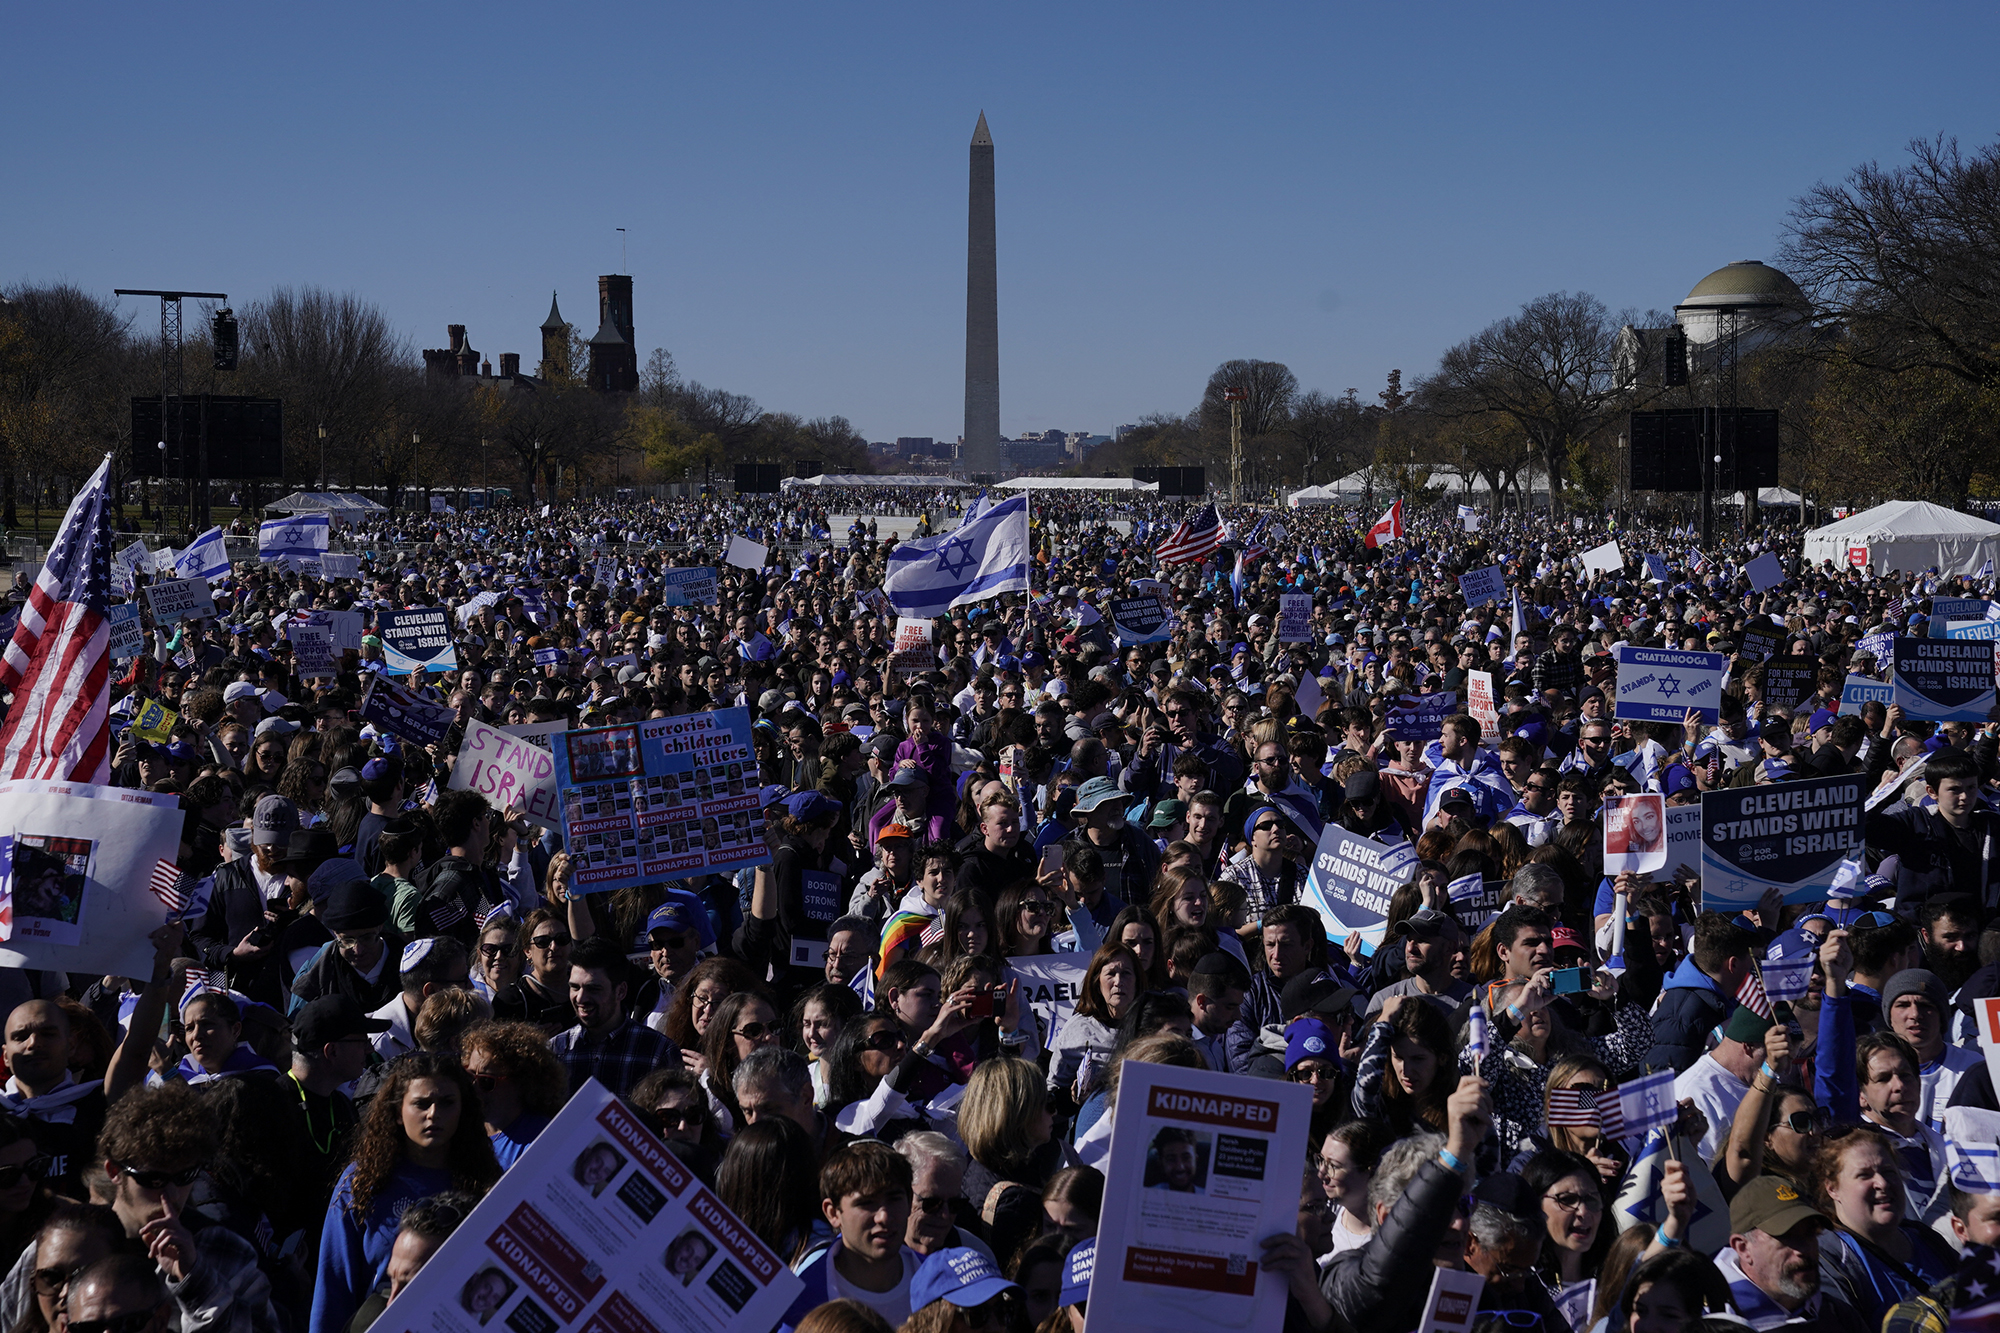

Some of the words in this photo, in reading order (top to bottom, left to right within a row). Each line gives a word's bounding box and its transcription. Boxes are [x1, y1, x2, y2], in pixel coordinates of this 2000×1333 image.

[599, 564, 615, 572] אחד
[670, 568, 708, 584] CLEVELAND
[1463, 569, 1489, 584] PHILLY
[152, 583, 190, 597] PHILLY
[682, 579, 712, 591] STRONGER
[1465, 581, 1482, 590] STANDS
[1467, 585, 1496, 599] ISRAEL
[154, 595, 179, 605] STANDS
[179, 592, 194, 600] WITH
[683, 590, 699, 599] THAN
[700, 587, 714, 597] HATE
[157, 600, 198, 615] ISRAEL
[1121, 598, 1158, 610] CLEVELAND
[1937, 601, 1981, 614] CLEVELAND
[394, 612, 444, 626] CLEVELAND
[1116, 609, 1142, 620] STANDS
[1142, 606, 1161, 616] WITH
[1140, 615, 1164, 626] ISRAEL
[123, 631, 141, 644] HATE
[300, 632, 320, 640] FREE
[384, 626, 422, 639] STANDS
[422, 624, 447, 635] WITH
[904, 626, 923, 635] FREE
[418, 636, 450, 648] ISRAEL
[895, 641, 931, 651] SUPPORT
[1745, 633, 1764, 644] BRING
[1765, 637, 1777, 647] THE
[1858, 632, 1894, 648] CHRISTIANS
[294, 646, 332, 655] SUPPORT
[1742, 641, 1774, 654] HOSTAGES
[1917, 644, 1991, 659] CLEVELAND
[1635, 652, 1709, 666] CHATTANOOGA
[1768, 669, 1781, 678] FOR
[1783, 669, 1794, 678] THE
[1795, 670, 1811, 678] SAKE
[1900, 659, 1954, 673] STANDS
[1956, 661, 1991, 675] WITH
[1472, 679, 1484, 690] FREE
[1621, 673, 1656, 694] STANDS
[1687, 679, 1712, 696] WITH
[1767, 678, 1775, 687] OF
[1777, 679, 1792, 687] ZION
[1946, 676, 1992, 690] ISRAEL
[1770, 688, 1785, 696] WILL
[1787, 688, 1799, 696] NOT
[370, 698, 386, 710] DC
[1468, 698, 1493, 711] SUPPORT
[1766, 696, 1774, 705] BE
[1651, 707, 1683, 718] ISRAEL
[403, 715, 441, 739] ISRAEL
[1388, 716, 1402, 725] DC
[644, 717, 713, 739] terrorist
[577, 736, 636, 754] hamas
[664, 733, 732, 754] children
[470, 728, 552, 778] STAND
[693, 747, 748, 767] killers
[470, 759, 558, 823] ISRAEL
[703, 797, 758, 814] KIDNAPPED
[1607, 800, 1617, 809] WE
[1740, 784, 1859, 816] CLEVELAND
[640, 809, 695, 825] KIDNAPPED
[1608, 808, 1624, 817] WANT
[572, 819, 629, 833] KIDNAPPED
[1712, 814, 1798, 842] STANDS
[1801, 806, 1858, 831] WITH
[1785, 830, 1859, 856] ISRAEL
[710, 846, 766, 862] KIDNAPPED
[1754, 853, 1779, 862] GOOD
[646, 857, 702, 873] KIDNAPPED
[1318, 852, 1368, 885] STANDS
[579, 867, 636, 882] KIDNAPPED
[807, 880, 837, 892] BOSTON
[1334, 886, 1346, 894] FOR
[804, 895, 837, 907] STRONG.
[1333, 892, 1348, 902] GOOD
[1351, 887, 1391, 916] ISRAE
[807, 910, 834, 922] ISRAEL
[1023, 982, 1081, 1003] RAEL
[1155, 1092, 1272, 1123] KIDNAPPED
[605, 1108, 684, 1189] KIDNAPPED
[695, 1196, 773, 1276] KIDNAPPED
[948, 1250, 978, 1268] BOSTO
[1134, 1252, 1158, 1263] Please
[1160, 1255, 1176, 1265] help
[1176, 1258, 1196, 1269] bring
[1197, 1261, 1215, 1270] them
[495, 1232, 576, 1313] KIDNAPPED
[1132, 1262, 1153, 1272] home
[1154, 1265, 1172, 1275] alive.
[959, 1268, 985, 1285] WITH
